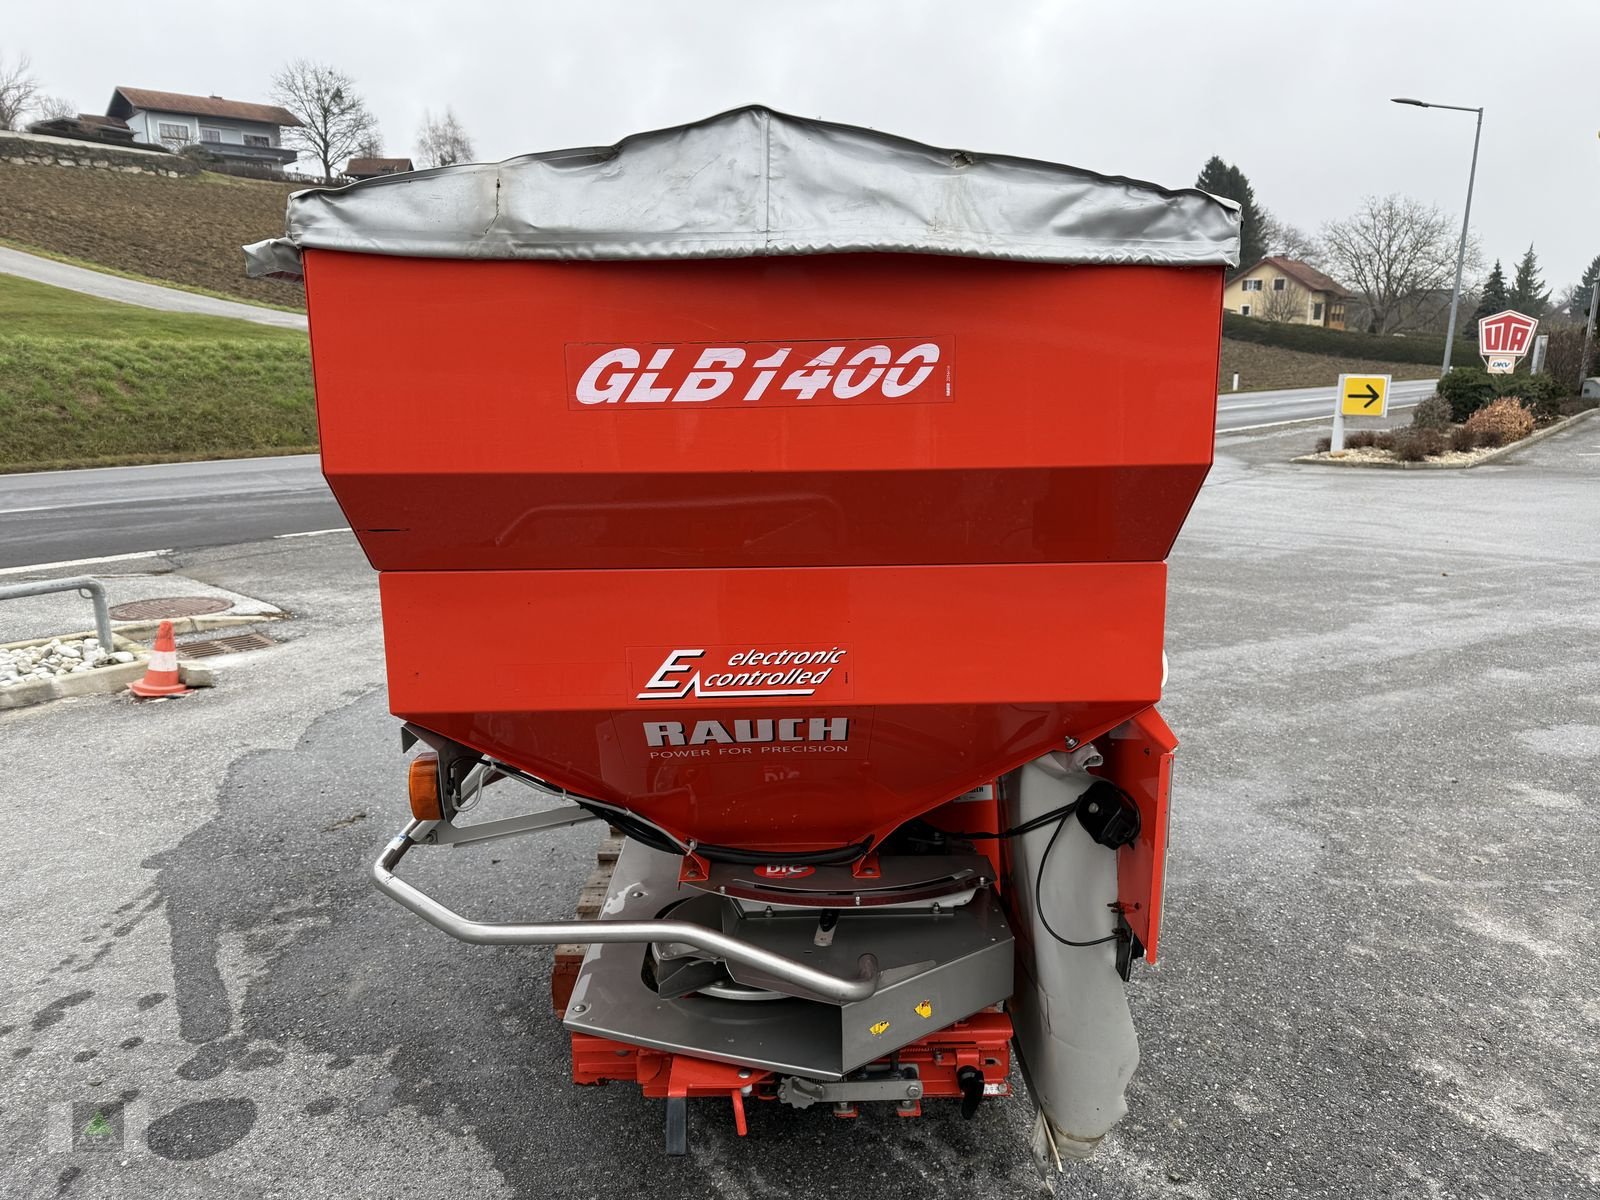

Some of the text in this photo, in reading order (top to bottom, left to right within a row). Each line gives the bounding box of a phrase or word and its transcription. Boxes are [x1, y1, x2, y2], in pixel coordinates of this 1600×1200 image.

[1484, 314, 1532, 352] UTA
[727, 646, 848, 666] electronic
[703, 667, 833, 687] controlled
[643, 717, 850, 748] RAUCH
[650, 745, 849, 760] POWER FOR PRECISION
